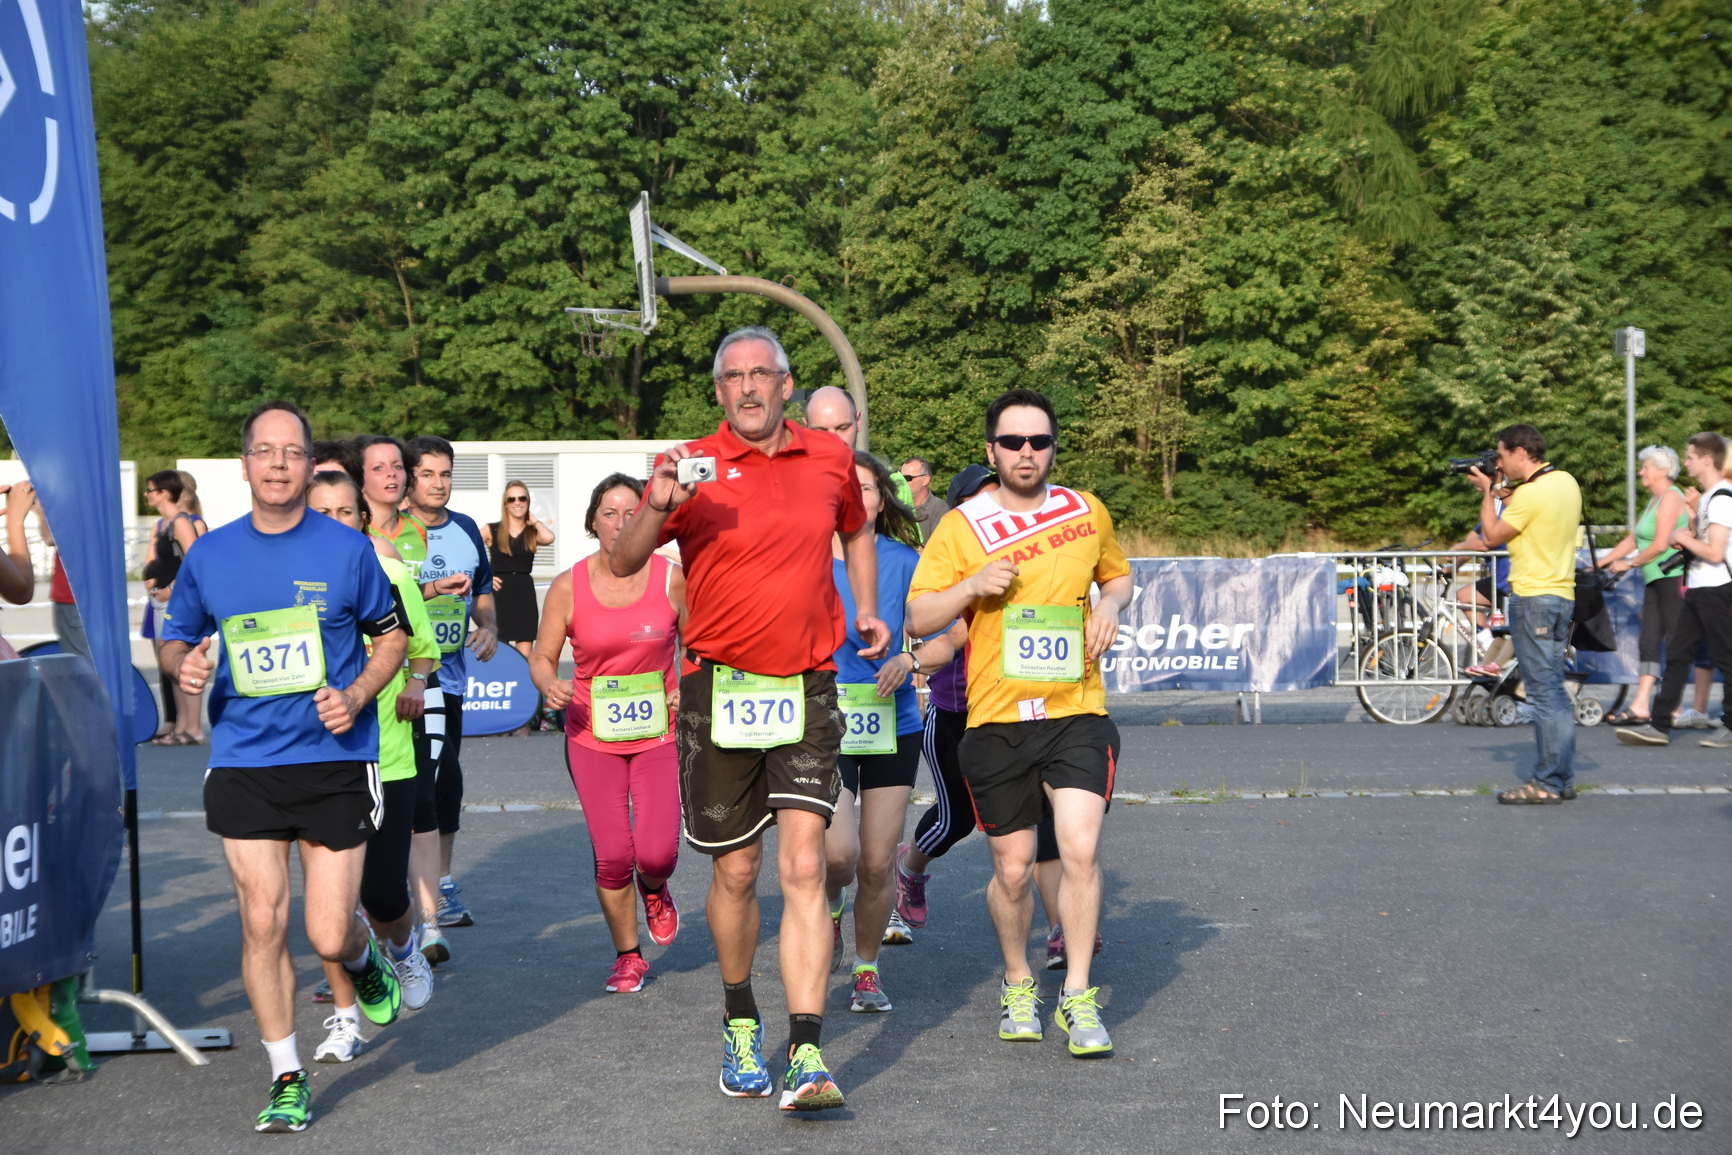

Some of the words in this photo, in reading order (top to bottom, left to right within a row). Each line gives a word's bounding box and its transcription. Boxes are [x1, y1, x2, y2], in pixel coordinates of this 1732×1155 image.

[1047, 521, 1097, 549] BÖGL
[430, 622, 462, 644] 98
[239, 640, 310, 674] 1371
[1018, 635, 1069, 661] 930
[1100, 655, 1239, 673] UTOMOBILE
[463, 676, 518, 699] her
[607, 700, 653, 724] 349
[722, 698, 795, 726] 1370
[843, 712, 881, 735] 38
